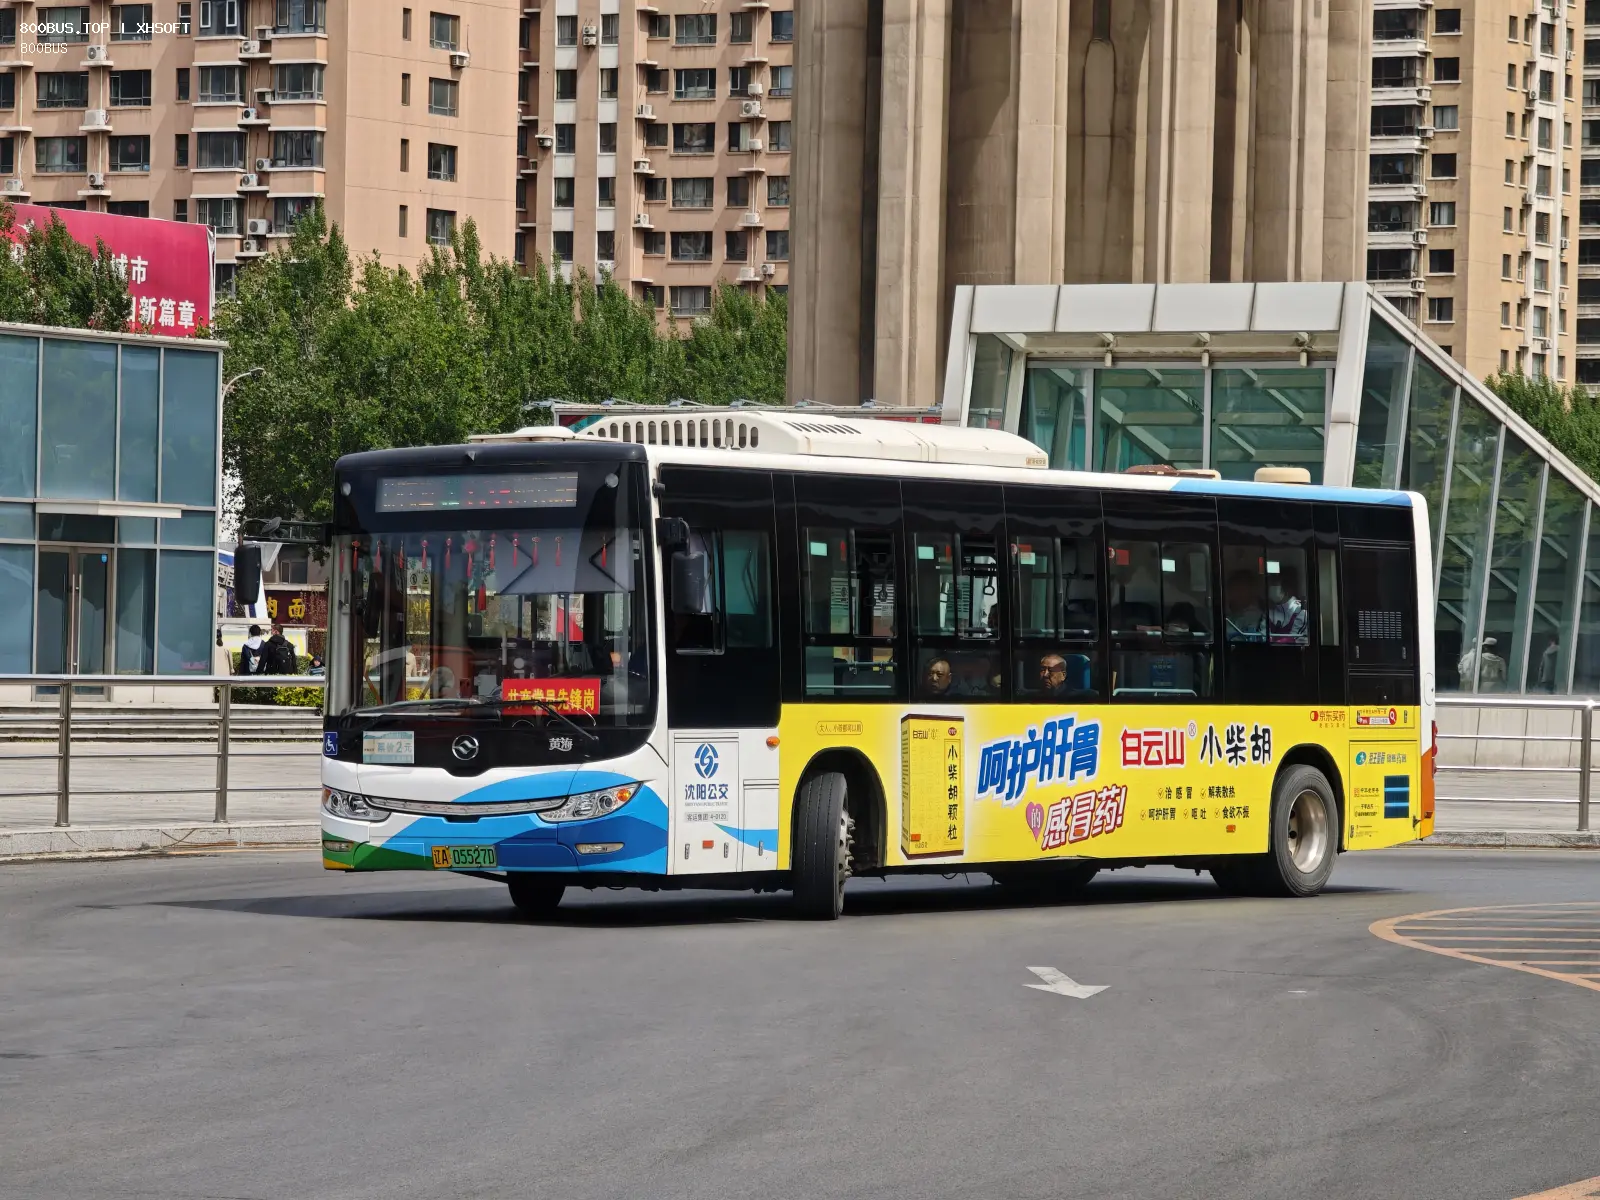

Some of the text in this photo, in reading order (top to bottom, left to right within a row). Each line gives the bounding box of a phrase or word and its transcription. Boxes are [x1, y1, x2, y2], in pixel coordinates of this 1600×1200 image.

[127, 296, 195, 329] 新篇章
[1319, 710, 1346, 722] 京东买药
[548, 737, 574, 752] 黄海
[1121, 728, 1186, 767] 白云山
[1200, 724, 1272, 766] 小柴胡
[977, 716, 1100, 800] 呵护肝胃
[684, 783, 729, 800] 沈阳公交
[947, 744, 958, 841] 小柴胡颗粒
[1208, 785, 1236, 799] 解表散热
[1222, 805, 1250, 820] 食欲不振
